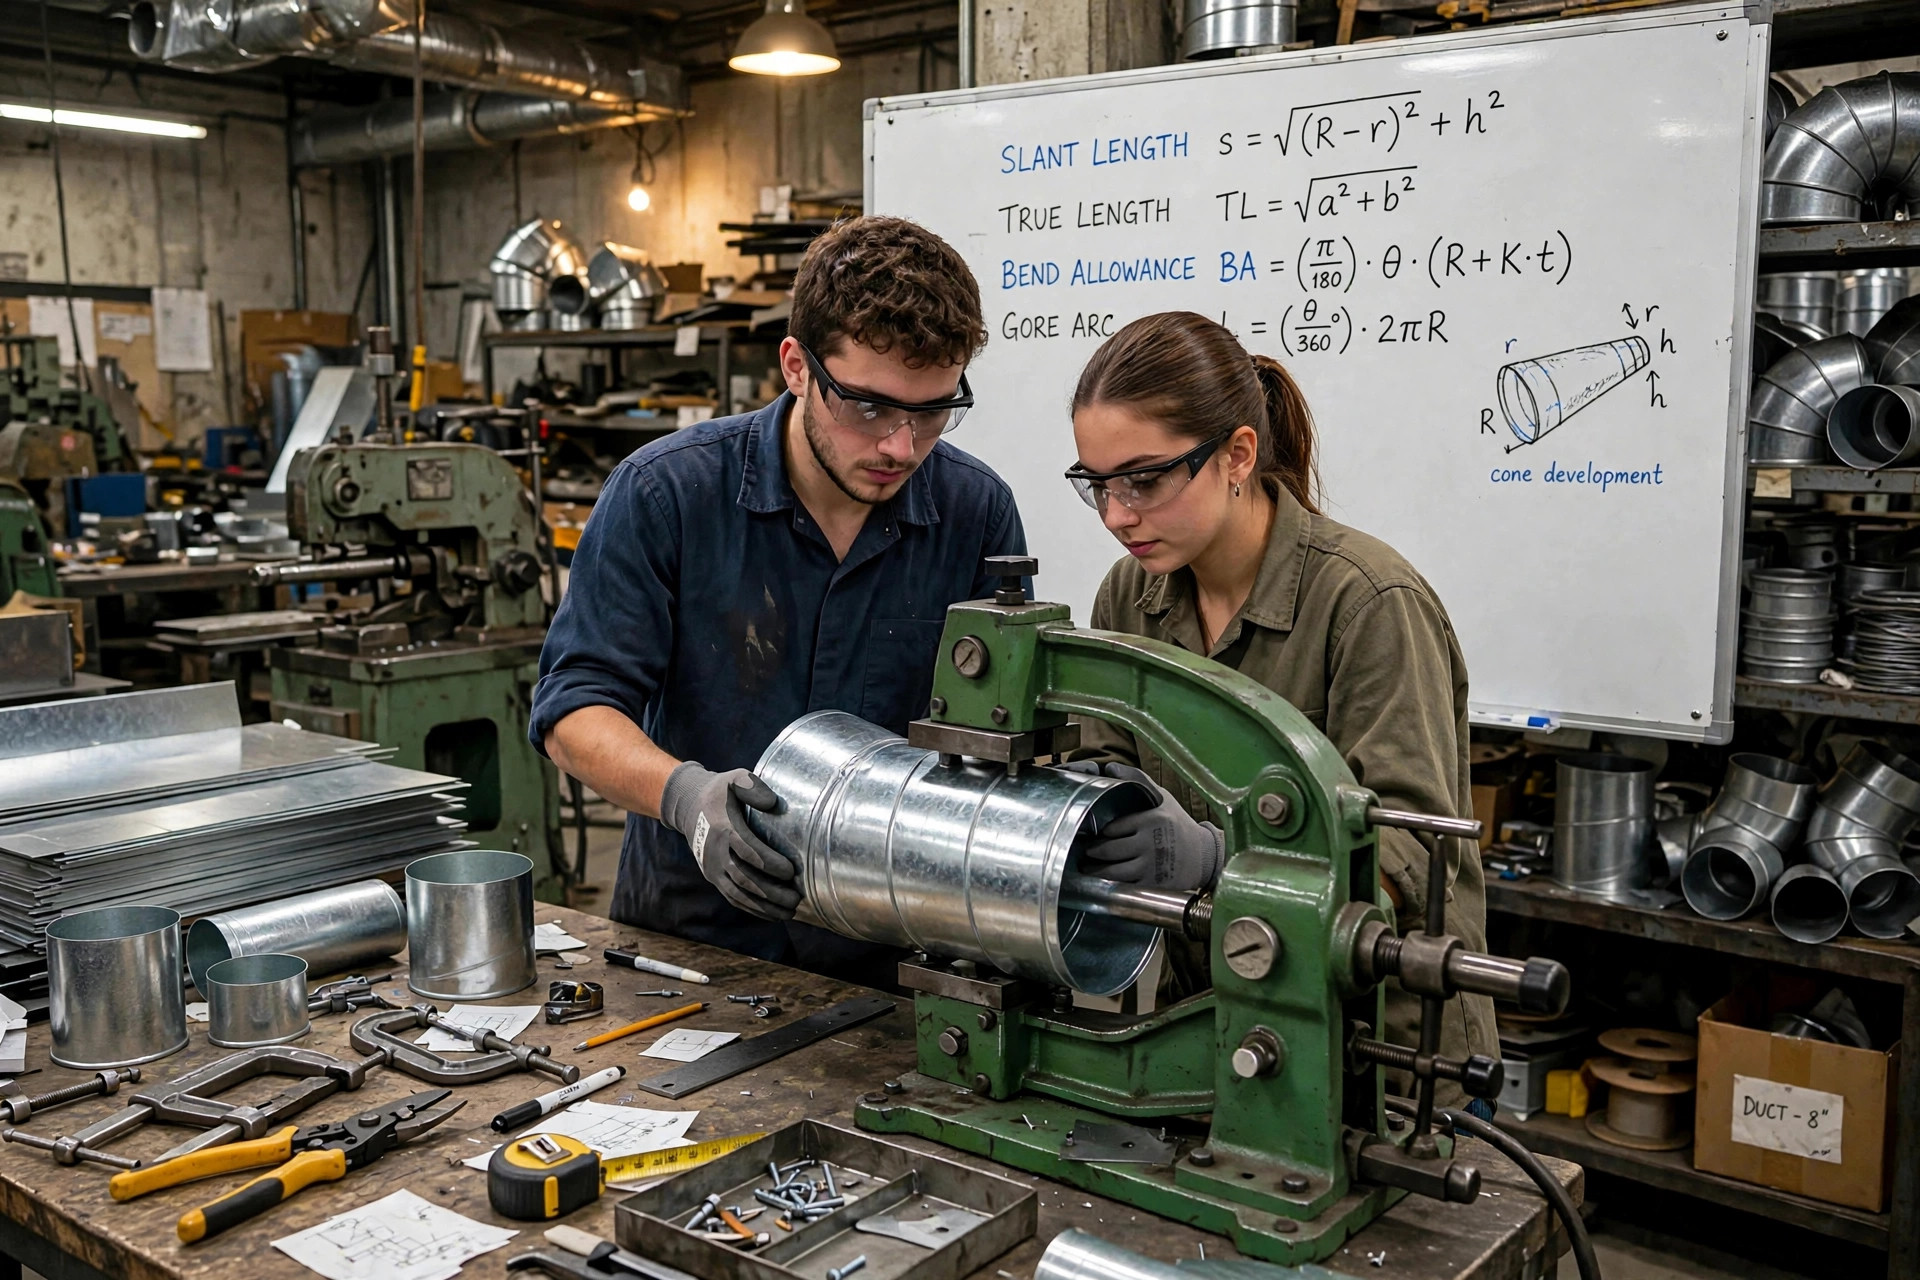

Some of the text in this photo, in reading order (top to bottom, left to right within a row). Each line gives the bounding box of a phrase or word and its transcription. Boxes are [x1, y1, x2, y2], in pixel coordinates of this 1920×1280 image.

[1001, 141, 1080, 174] SLANT
[1092, 131, 1188, 167] LENGTH
[998, 203, 1063, 234] TRUE
[1077, 197, 1171, 229] LENGTH
[1216, 190, 1258, 222] TL
[1002, 259, 1060, 290] BEND
[1070, 256, 1196, 287] ALLOWANCE
[1219, 250, 1257, 283] BA
[1002, 311, 1060, 341] GORE
[1071, 311, 1115, 339] ARC
[1646, 304, 1660, 323] r
[1504, 337, 1518, 355] r
[1660, 327, 1677, 355] h
[1650, 389, 1668, 409] h
[1480, 407, 1497, 435] R
[1490, 460, 1664, 494] cone development
[1743, 1095, 1789, 1121] DUCT
